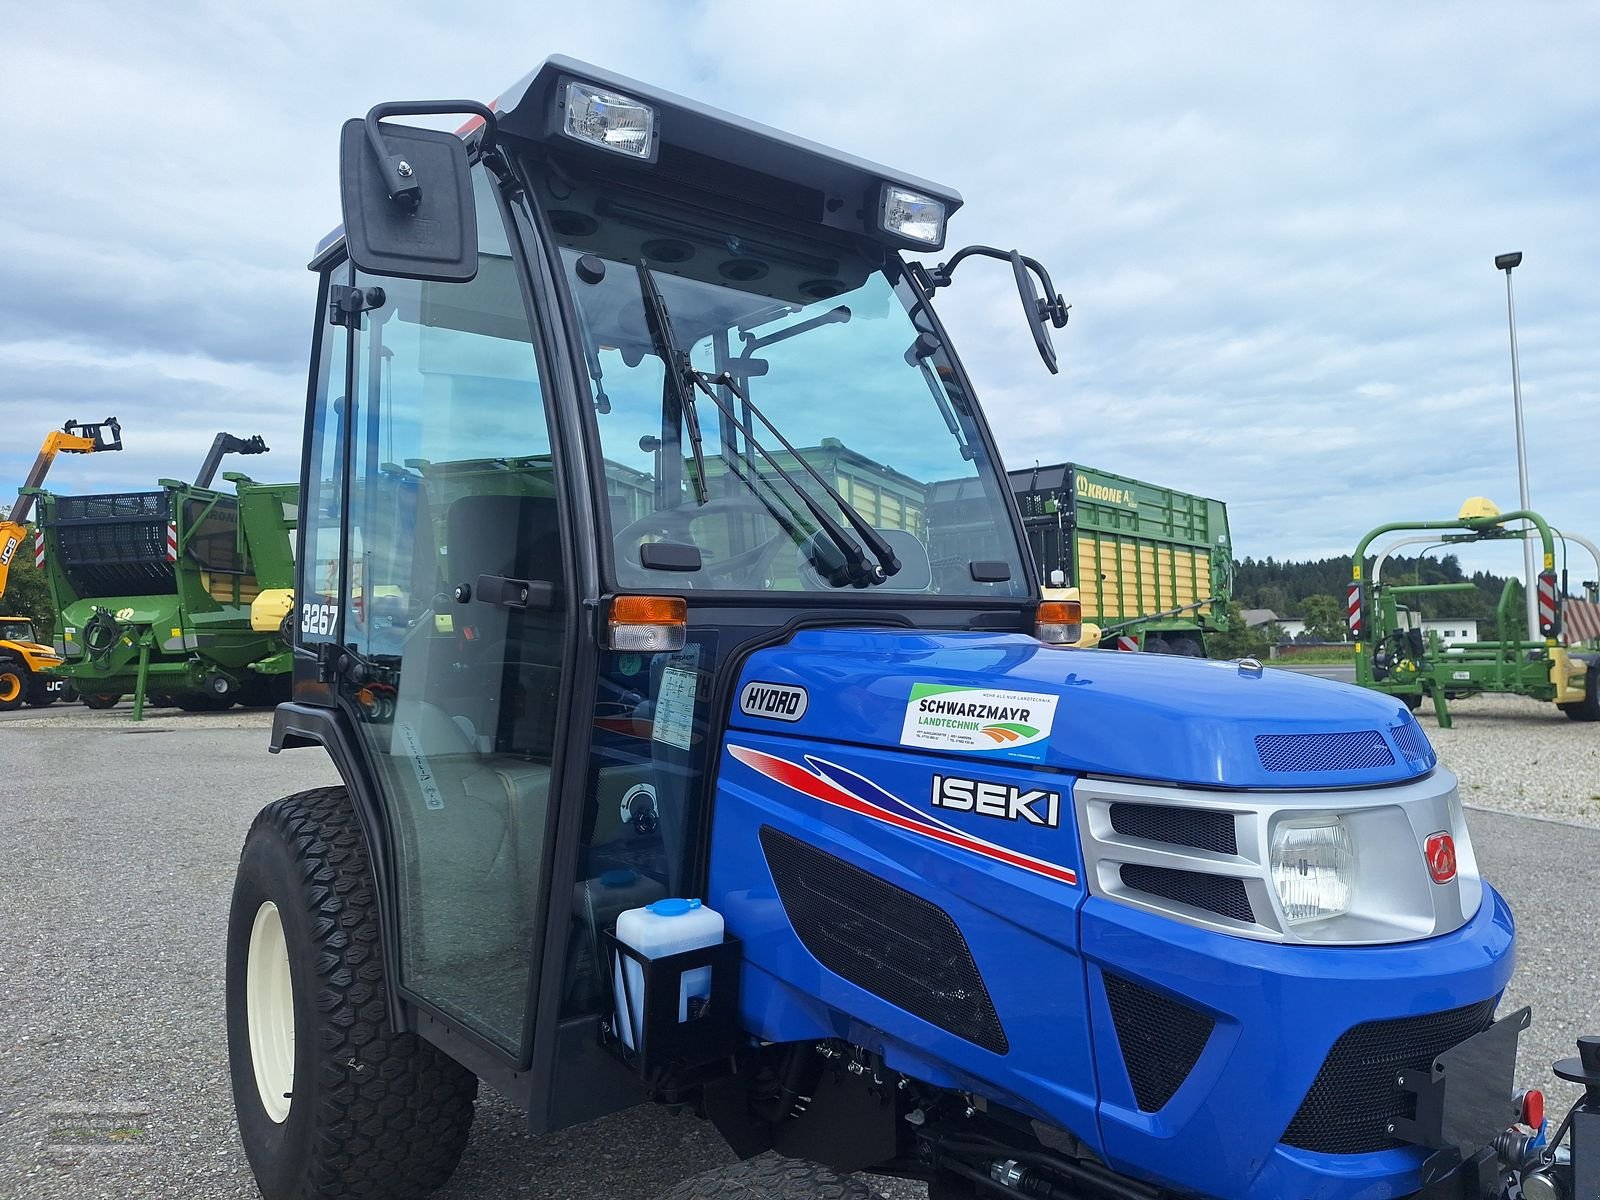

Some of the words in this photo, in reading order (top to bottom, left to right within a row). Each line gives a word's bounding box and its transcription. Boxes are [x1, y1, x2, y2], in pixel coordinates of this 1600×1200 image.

[1088, 483, 1122, 504] KRONE
[1, 537, 17, 565] JCB
[301, 603, 339, 636] 3267
[46, 681, 64, 691] JC
[745, 687, 801, 715] HYDRO
[918, 698, 1031, 723] SCHWARZMAYR
[918, 716, 980, 732] LANDTECHNIK
[931, 774, 1060, 829] ISEKI
